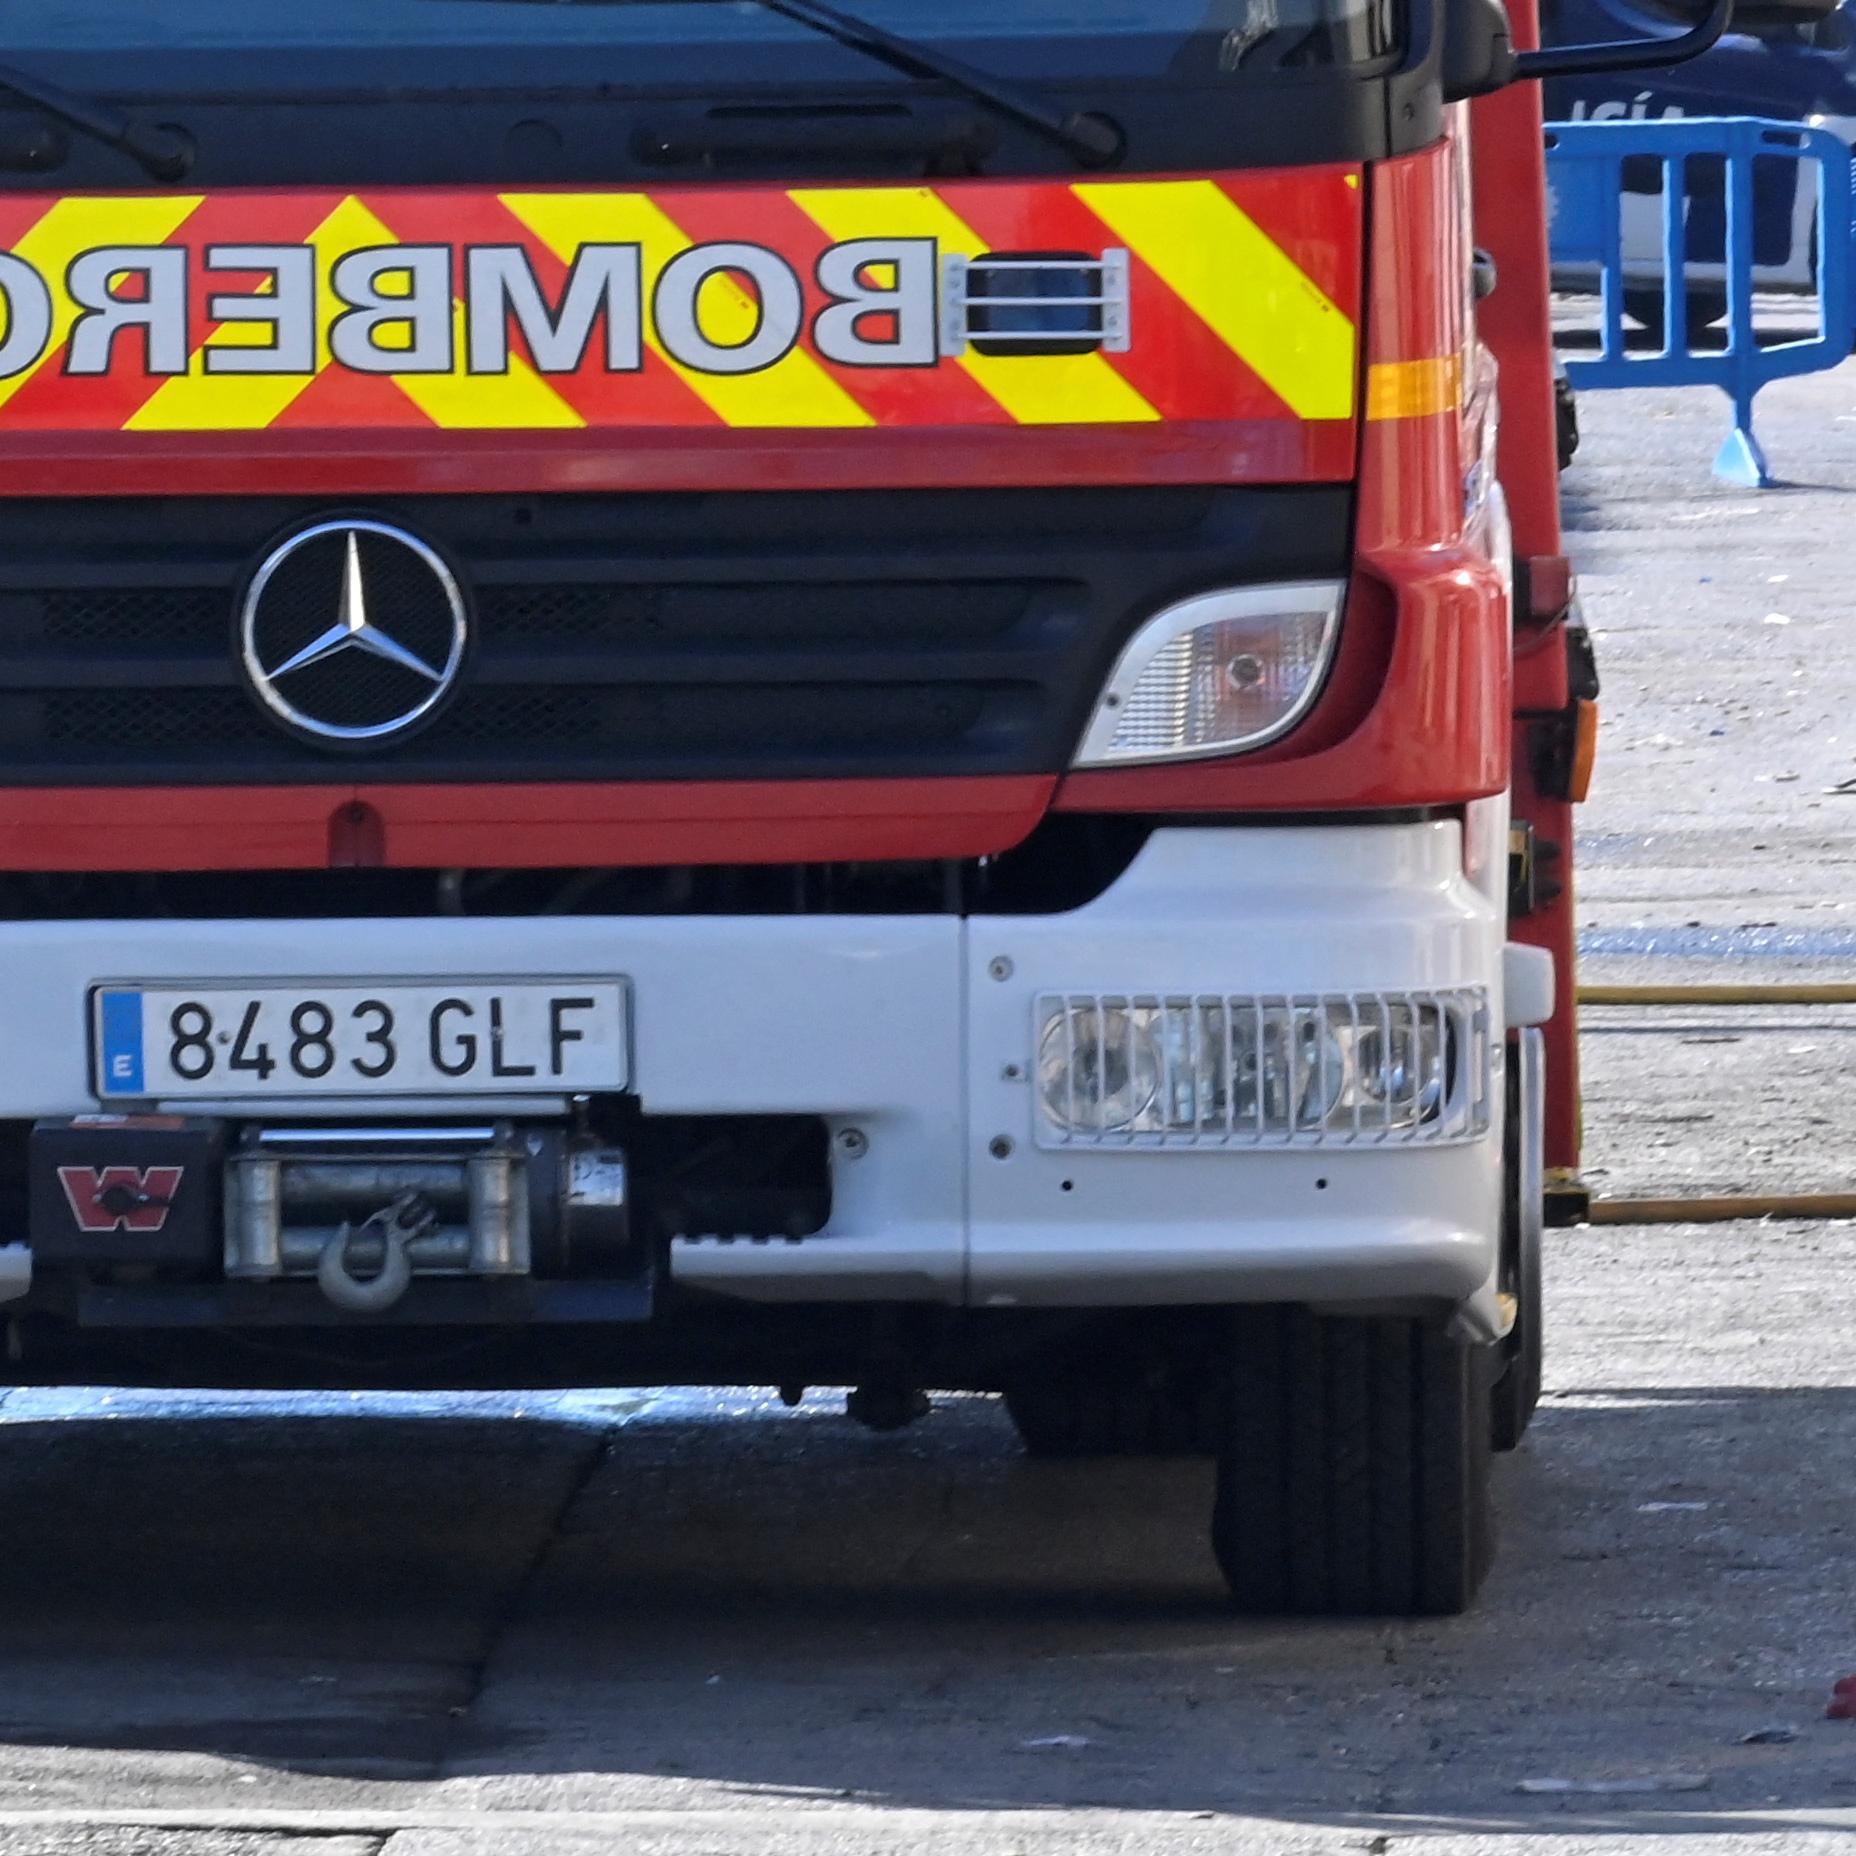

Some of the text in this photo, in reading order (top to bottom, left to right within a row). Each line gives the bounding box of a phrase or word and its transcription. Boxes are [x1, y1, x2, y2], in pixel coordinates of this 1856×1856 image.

[168, 996, 597, 1081] 8483 GLF
[111, 1054, 133, 1079] E
